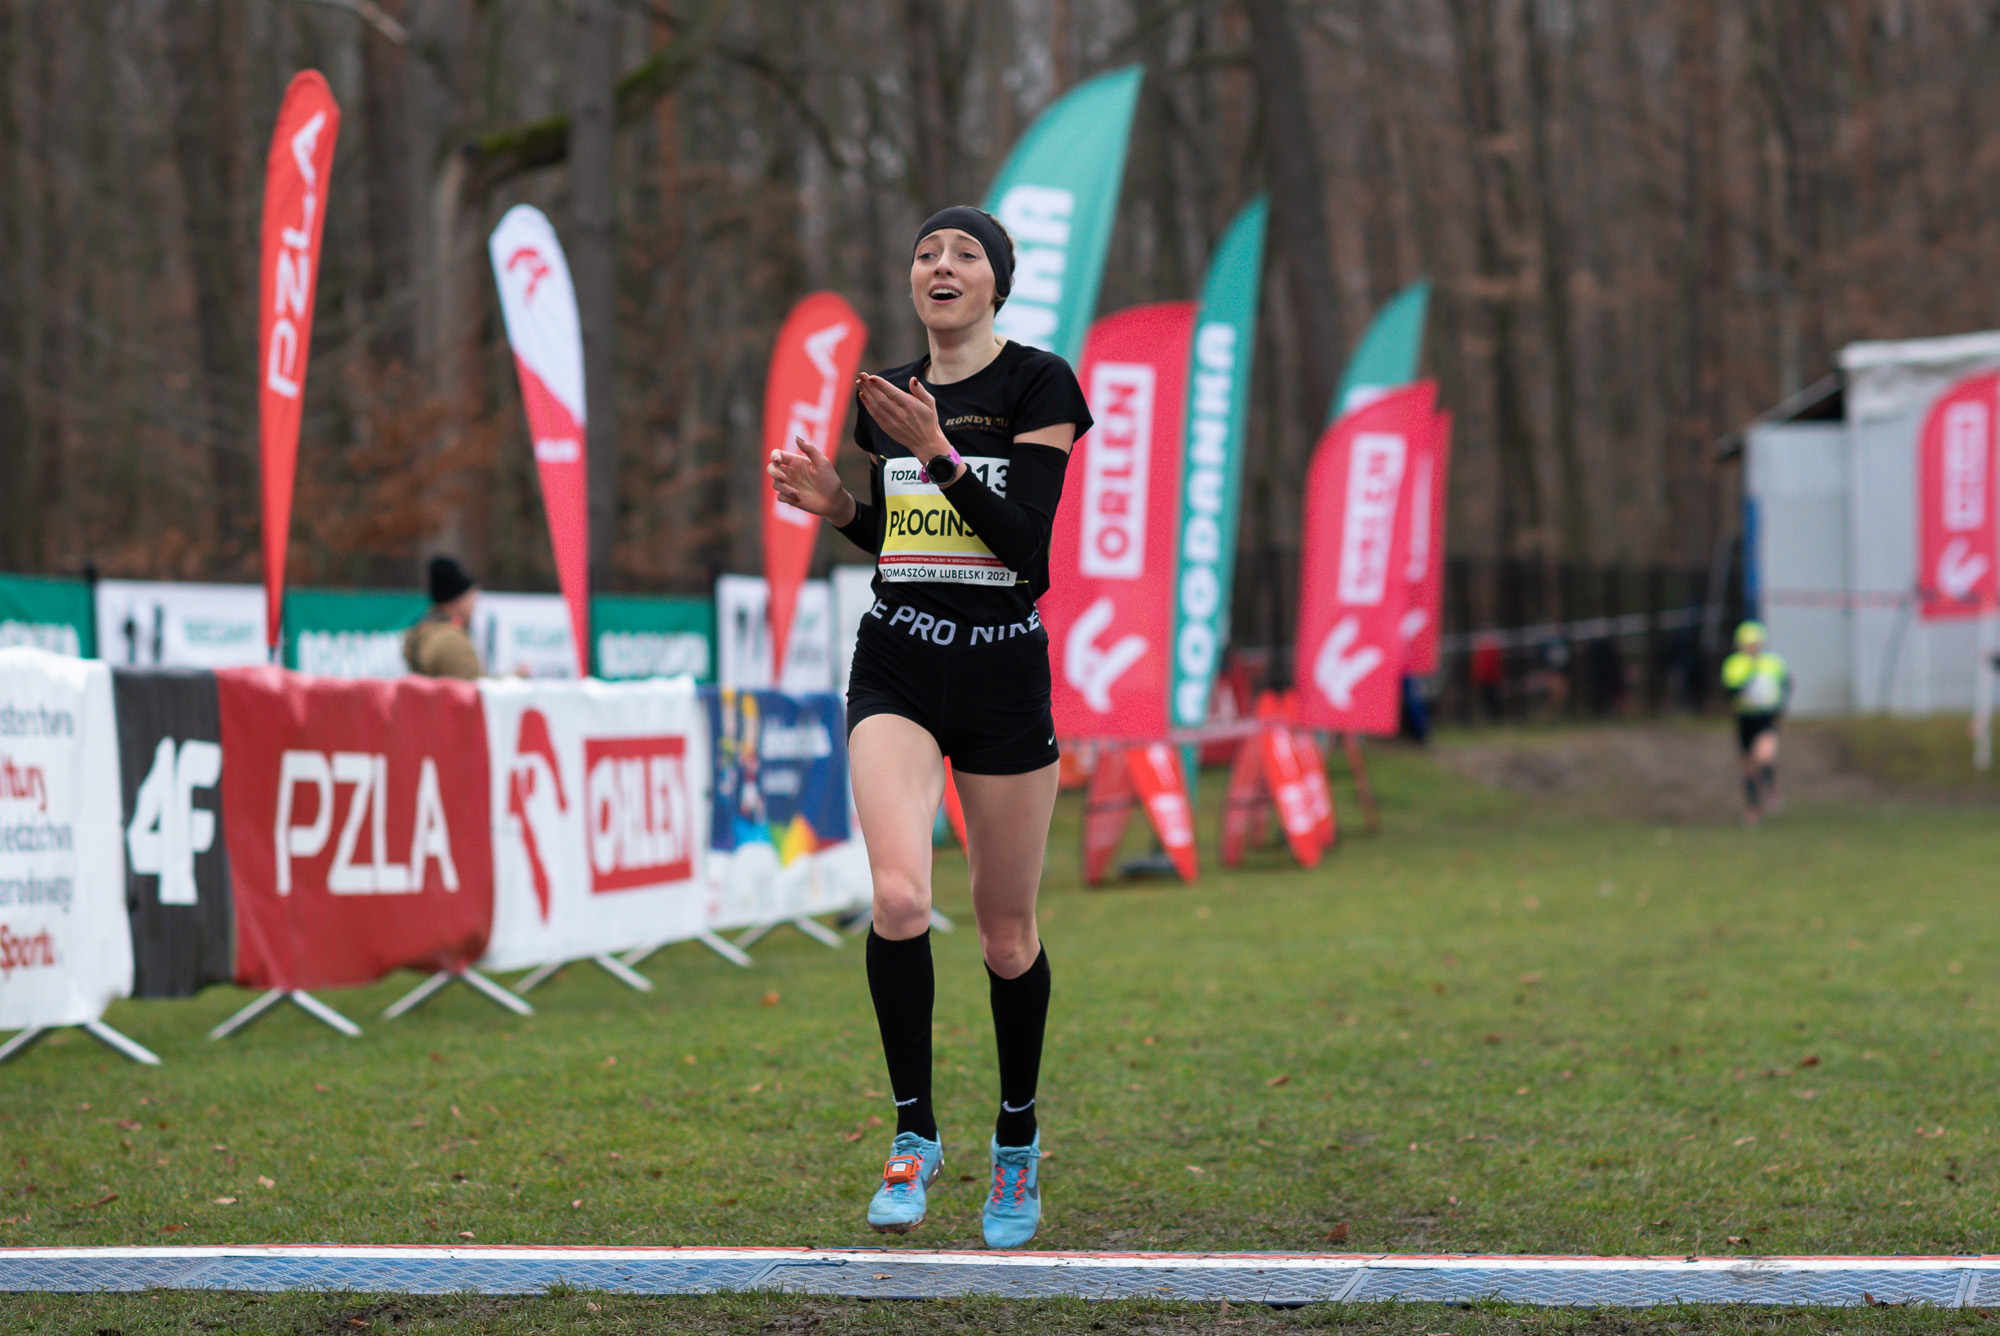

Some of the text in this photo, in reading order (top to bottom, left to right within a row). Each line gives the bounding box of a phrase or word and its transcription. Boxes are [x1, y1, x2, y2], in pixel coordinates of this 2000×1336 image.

[267, 110, 327, 398] PZLA
[964, 463, 1009, 492] 13
[1096, 383, 1138, 561] ORLEN
[888, 508, 976, 538] PŁOCIN
[883, 566, 1010, 581] TOMASZÓW LUBELSKI 2021
[889, 605, 956, 646] PRO
[127, 736, 222, 905] 4F
[275, 749, 460, 897] PZLA
